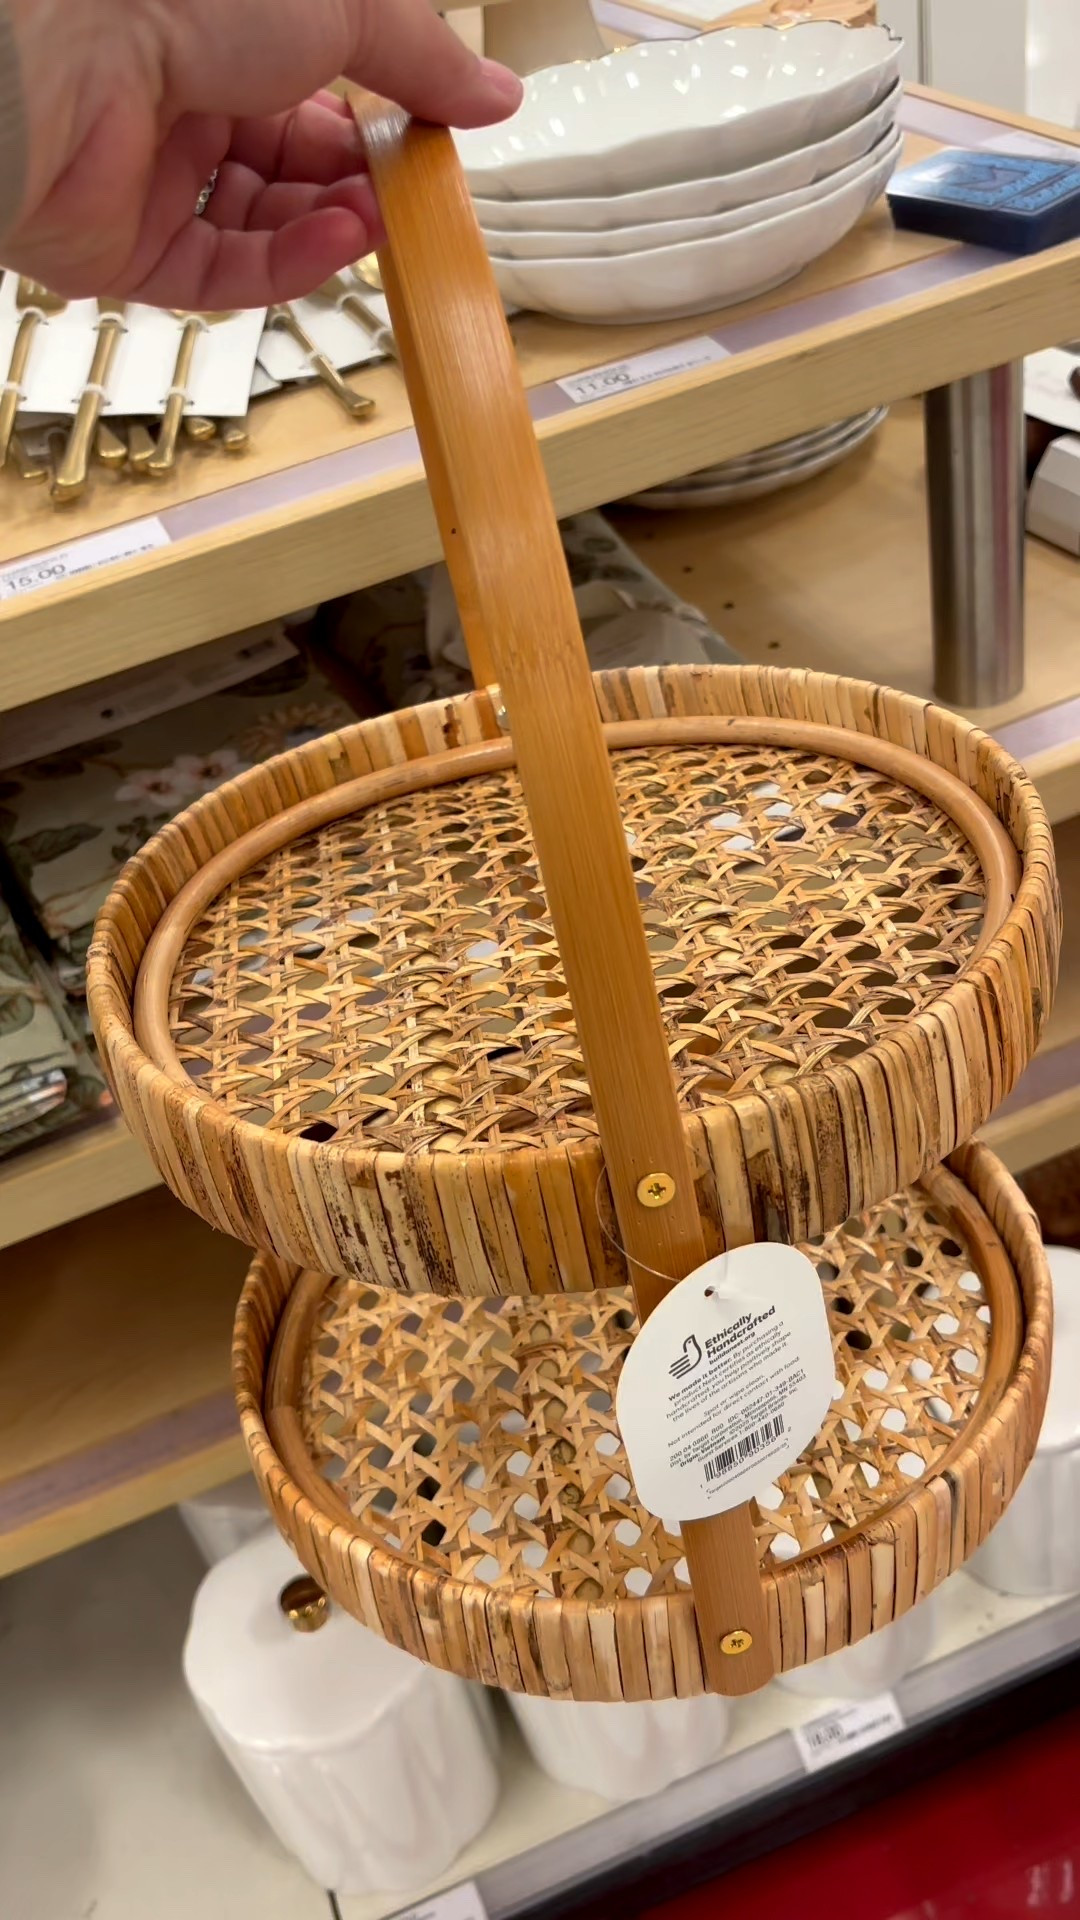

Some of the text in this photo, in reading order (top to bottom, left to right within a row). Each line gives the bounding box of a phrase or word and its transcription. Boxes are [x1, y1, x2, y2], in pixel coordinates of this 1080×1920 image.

[9, 563, 67, 591] 15.00
[704, 1312, 751, 1349] Ethically
[706, 1305, 775, 1358] Handcrafted
[708, 1331, 755, 1365] buildanest.org
[668, 1392, 680, 1401] We
[681, 1377, 701, 1394] made
[732, 1350, 741, 1359] By
[742, 1325, 778, 1354] purchasing
[672, 1412, 684, 1422] the
[684, 1401, 700, 1414] lives
[700, 1394, 708, 1403] of
[708, 1388, 720, 1397] the
[720, 1369, 748, 1389] artisans
[748, 1359, 763, 1371] who
[762, 1346, 781, 1361] made
[673, 1384, 701, 1407] product
[702, 1374, 718, 1387] Nest
[718, 1355, 745, 1376] certifies
[754, 1330, 781, 1352] ethically
[711, 1377, 724, 1389] you
[724, 1367, 739, 1379] help
[740, 1345, 770, 1370] positively
[771, 1331, 791, 1348] shape
[667, 1436, 680, 1448] Not
[681, 1415, 712, 1438] intended
[712, 1409, 721, 1418] for
[723, 1395, 743, 1411] direct
[743, 1377, 768, 1397] contact
[769, 1367, 783, 1379] with
[692, 1439, 710, 1453] Target
[778, 1386, 788, 1395] MN
[788, 1373, 806, 1389] 55403
[703, 1374, 765, 1417] Spot or wipe clean.
[697, 1449, 714, 1462] Guest
[714, 1433, 738, 1451] Services
[700, 1435, 725, 1454] Vietnam
[750, 1406, 767, 1421] Target
[715, 1457, 745, 1479] 98850
[748, 1436, 776, 1458] 90356
